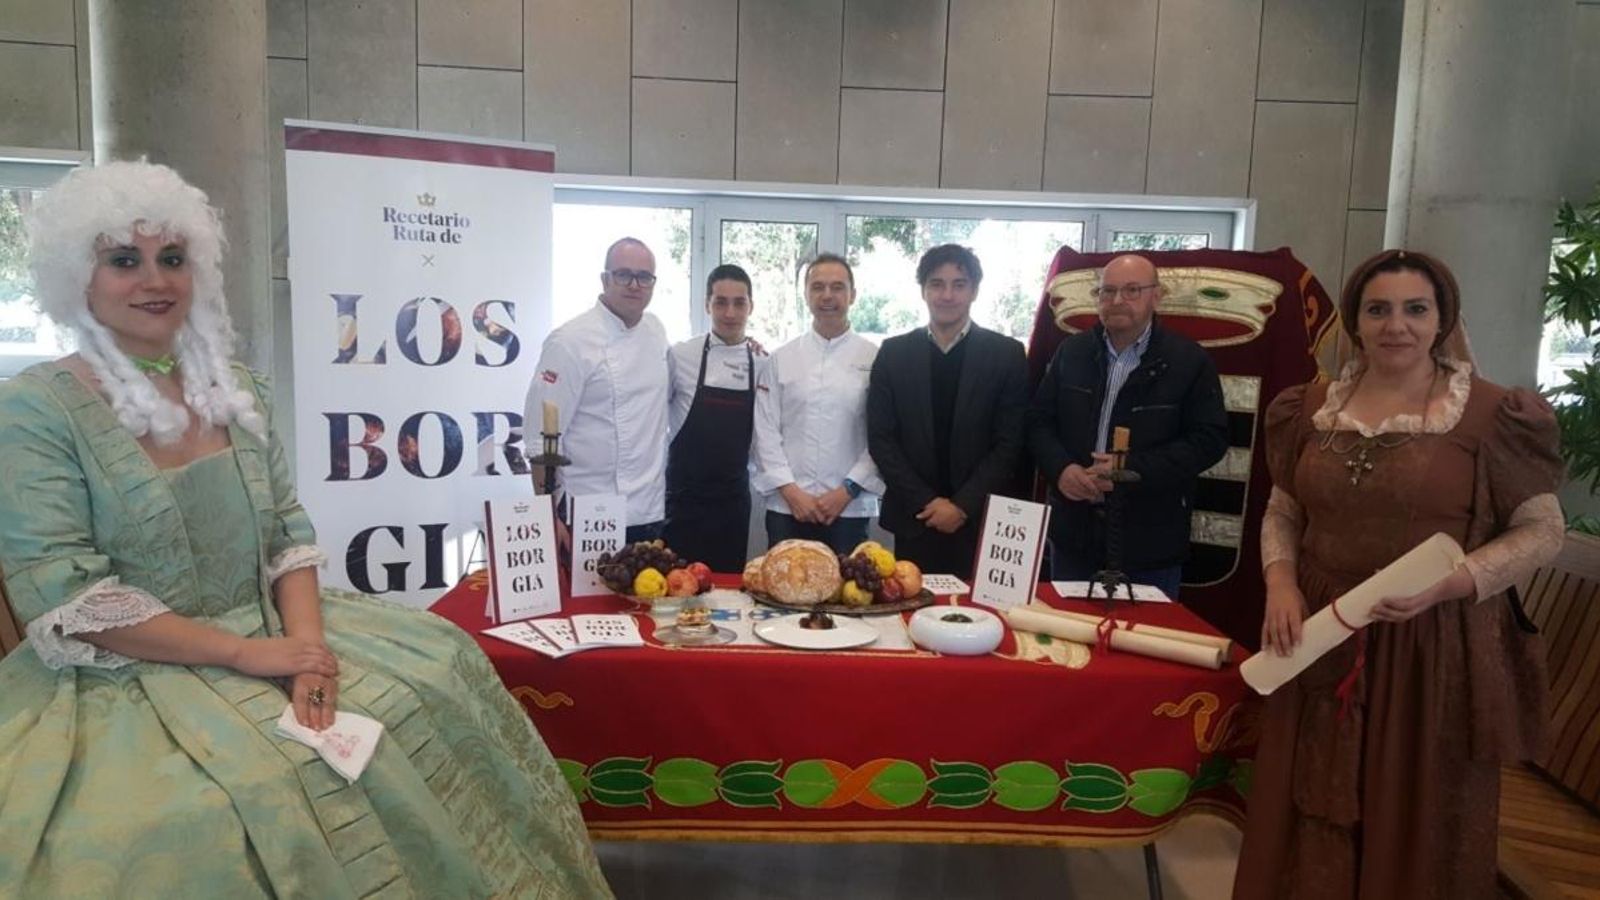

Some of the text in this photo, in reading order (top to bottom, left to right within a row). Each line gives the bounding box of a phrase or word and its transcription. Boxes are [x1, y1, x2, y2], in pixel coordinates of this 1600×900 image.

[383, 206, 470, 228] Recetario
[393, 224, 462, 244] Ruta de
[329, 293, 521, 368] LOS
[321, 410, 531, 482] BOR
[506, 522, 541, 543] LOS
[584, 519, 617, 533] LOS
[995, 521, 1027, 542] LOS
[582, 539, 617, 552] BOR
[990, 544, 1024, 566] BOR
[507, 548, 545, 569] BOR
[512, 573, 544, 594] GIA
[988, 567, 1016, 588] GIA
